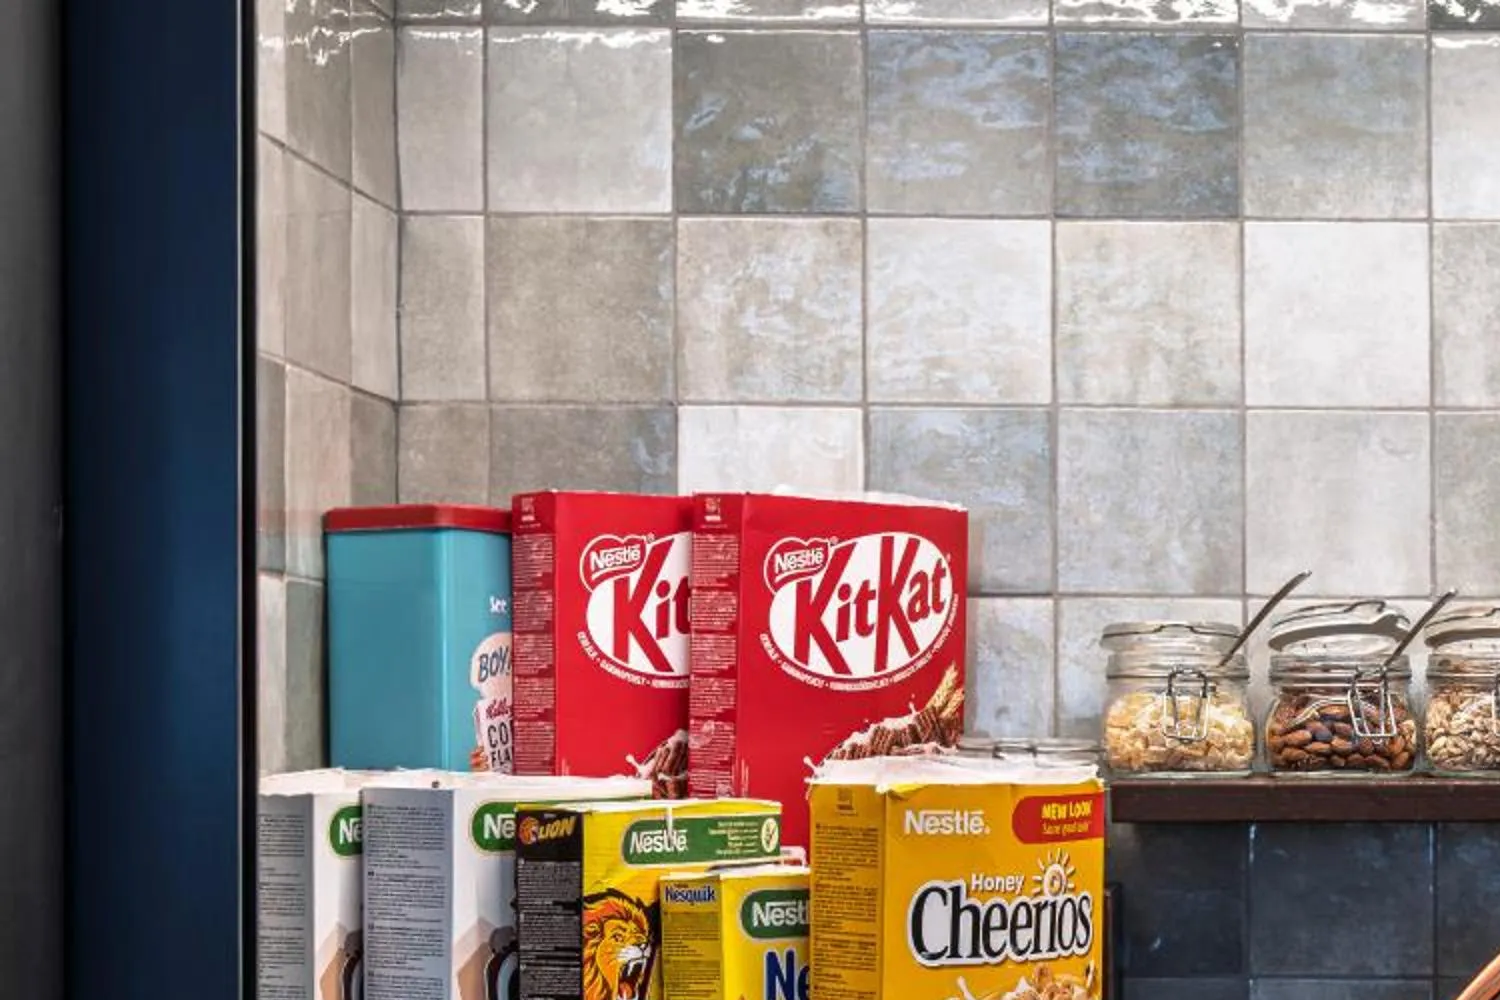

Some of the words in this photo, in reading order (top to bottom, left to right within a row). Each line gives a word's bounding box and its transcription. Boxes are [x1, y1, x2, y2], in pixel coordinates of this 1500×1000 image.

[589, 544, 641, 571] Nestlé
[774, 548, 824, 573] Nestlé
[613, 537, 691, 673] Kit
[794, 535, 947, 675] KitKat
[904, 809, 986, 835] Nestlé
[629, 829, 688, 854] Nestlé
[665, 884, 716, 906] Nesquik
[971, 873, 1025, 895] Honey
[910, 884, 1092, 962] Cheerios
